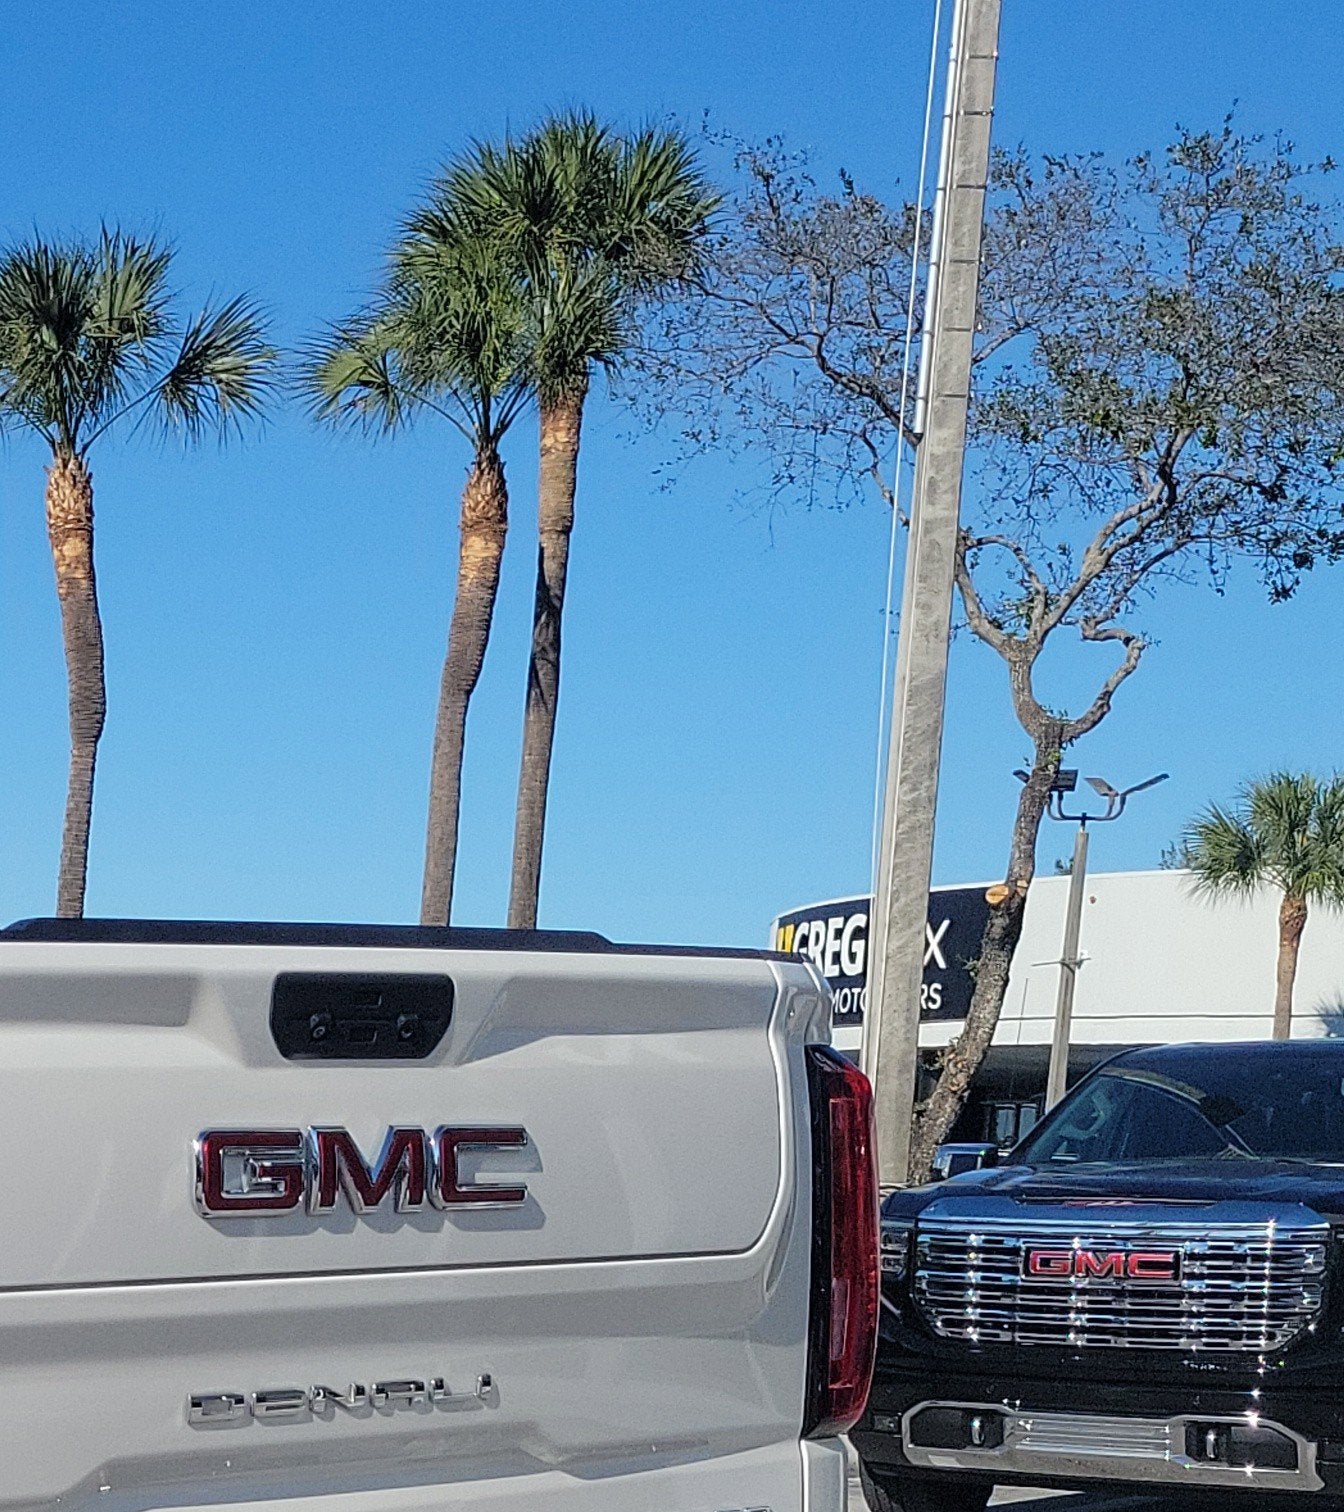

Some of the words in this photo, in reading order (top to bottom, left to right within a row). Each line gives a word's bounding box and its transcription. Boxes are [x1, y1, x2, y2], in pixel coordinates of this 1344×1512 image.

[192, 1124, 528, 1219] GMC
[1029, 1250, 1175, 1279] GMC
[188, 1374, 492, 1424] DENALI
